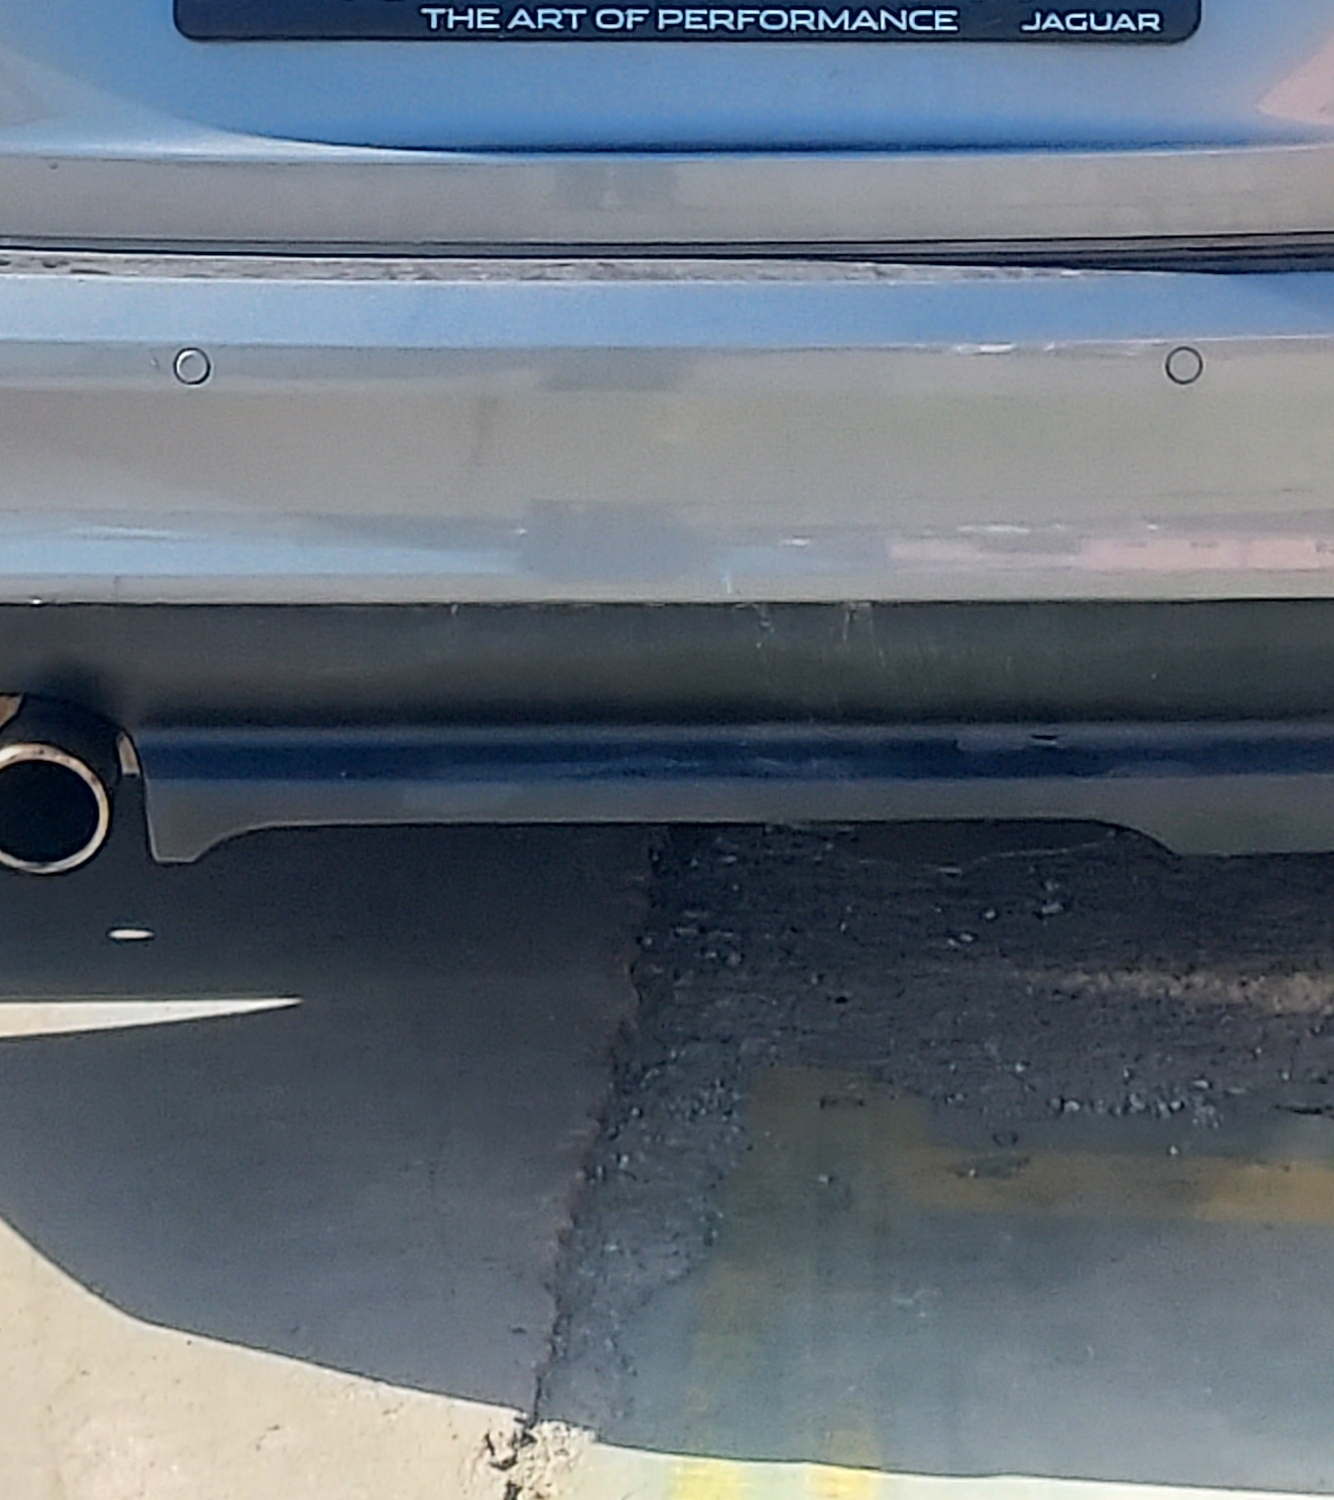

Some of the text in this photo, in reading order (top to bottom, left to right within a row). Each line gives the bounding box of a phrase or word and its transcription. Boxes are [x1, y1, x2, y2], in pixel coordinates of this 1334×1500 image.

[420, 7, 959, 32] THE ART OF PERFORMANCE
[1020, 10, 1162, 33] JAGUAR
